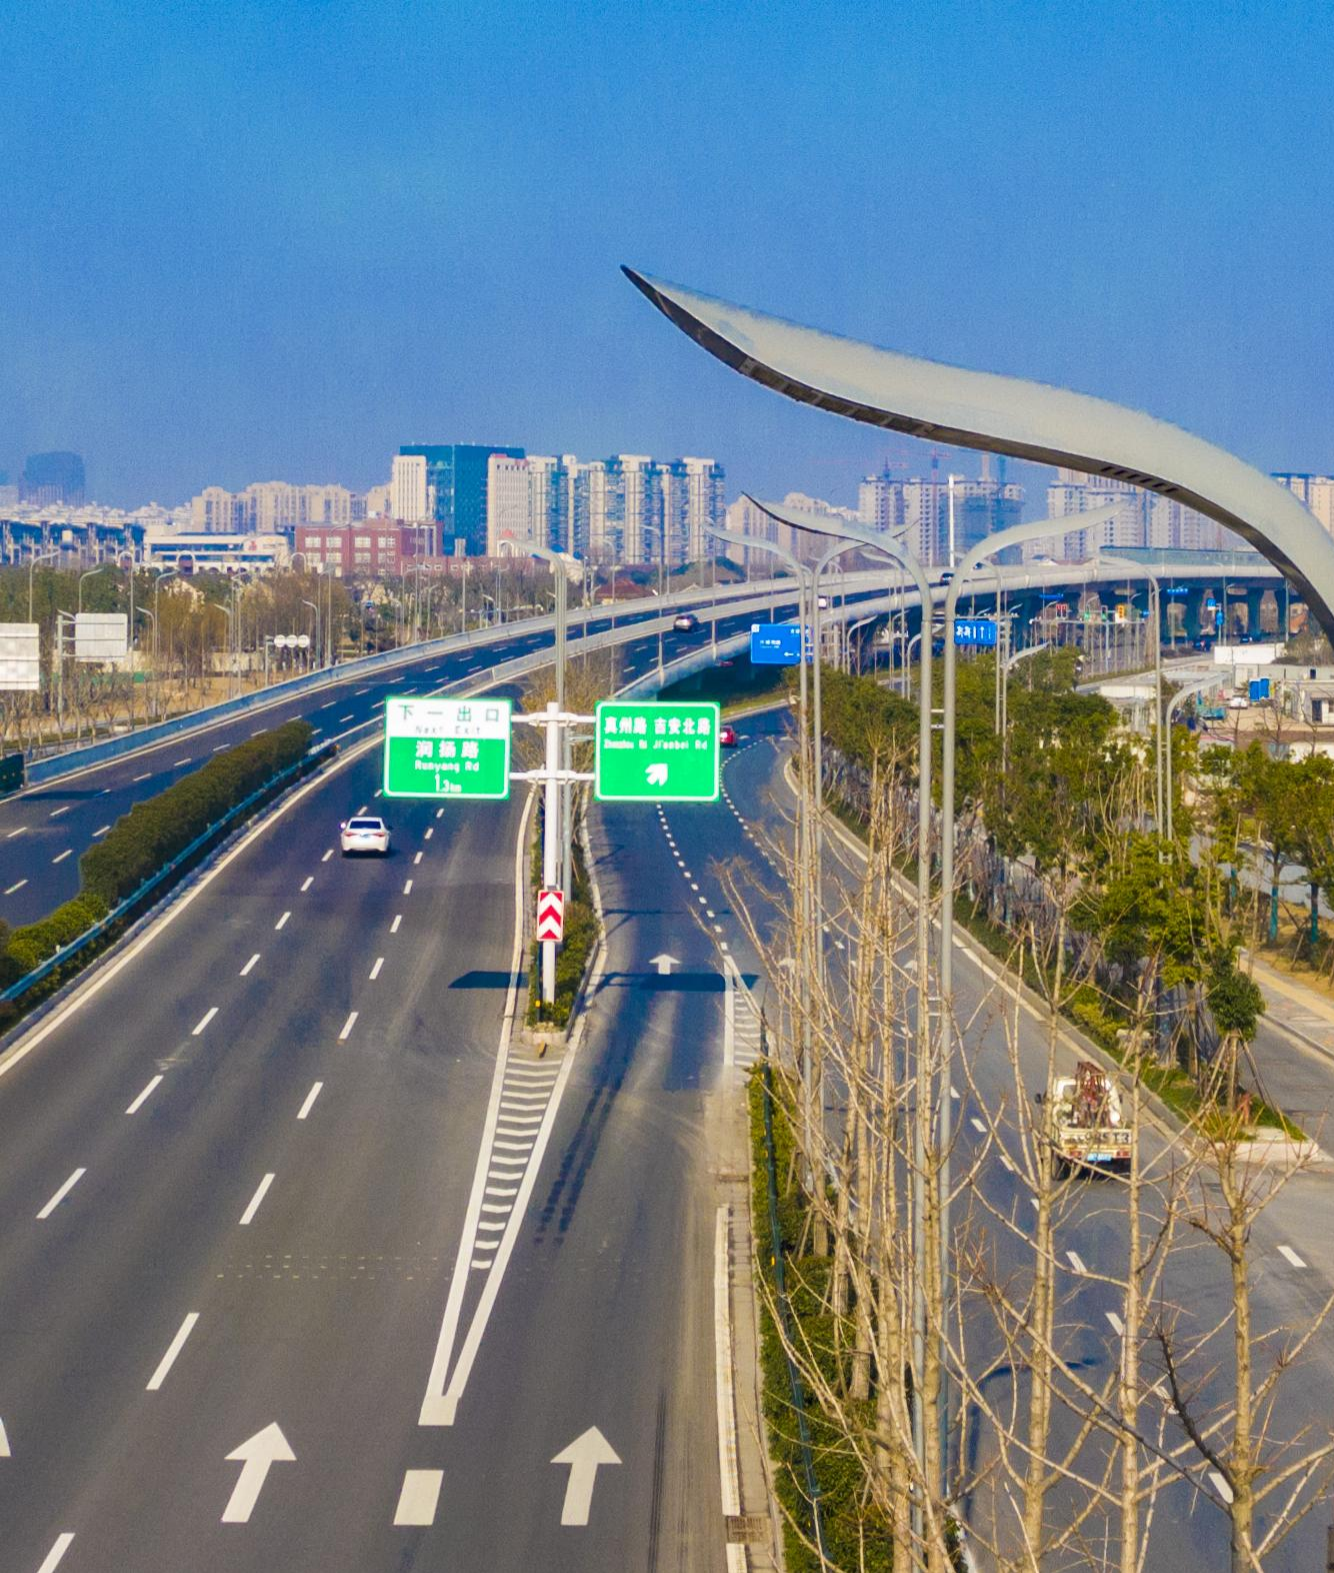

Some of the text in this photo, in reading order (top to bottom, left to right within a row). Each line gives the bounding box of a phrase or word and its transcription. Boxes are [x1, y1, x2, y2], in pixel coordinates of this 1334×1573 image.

[398, 704, 499, 722] 下一出口
[415, 725, 480, 735] Next Exit
[604, 716, 710, 735] 真州路 吉安北路
[415, 740, 479, 759] 润扬路
[695, 740, 708, 750] Rd
[414, 760, 480, 774] Runyang Rd
